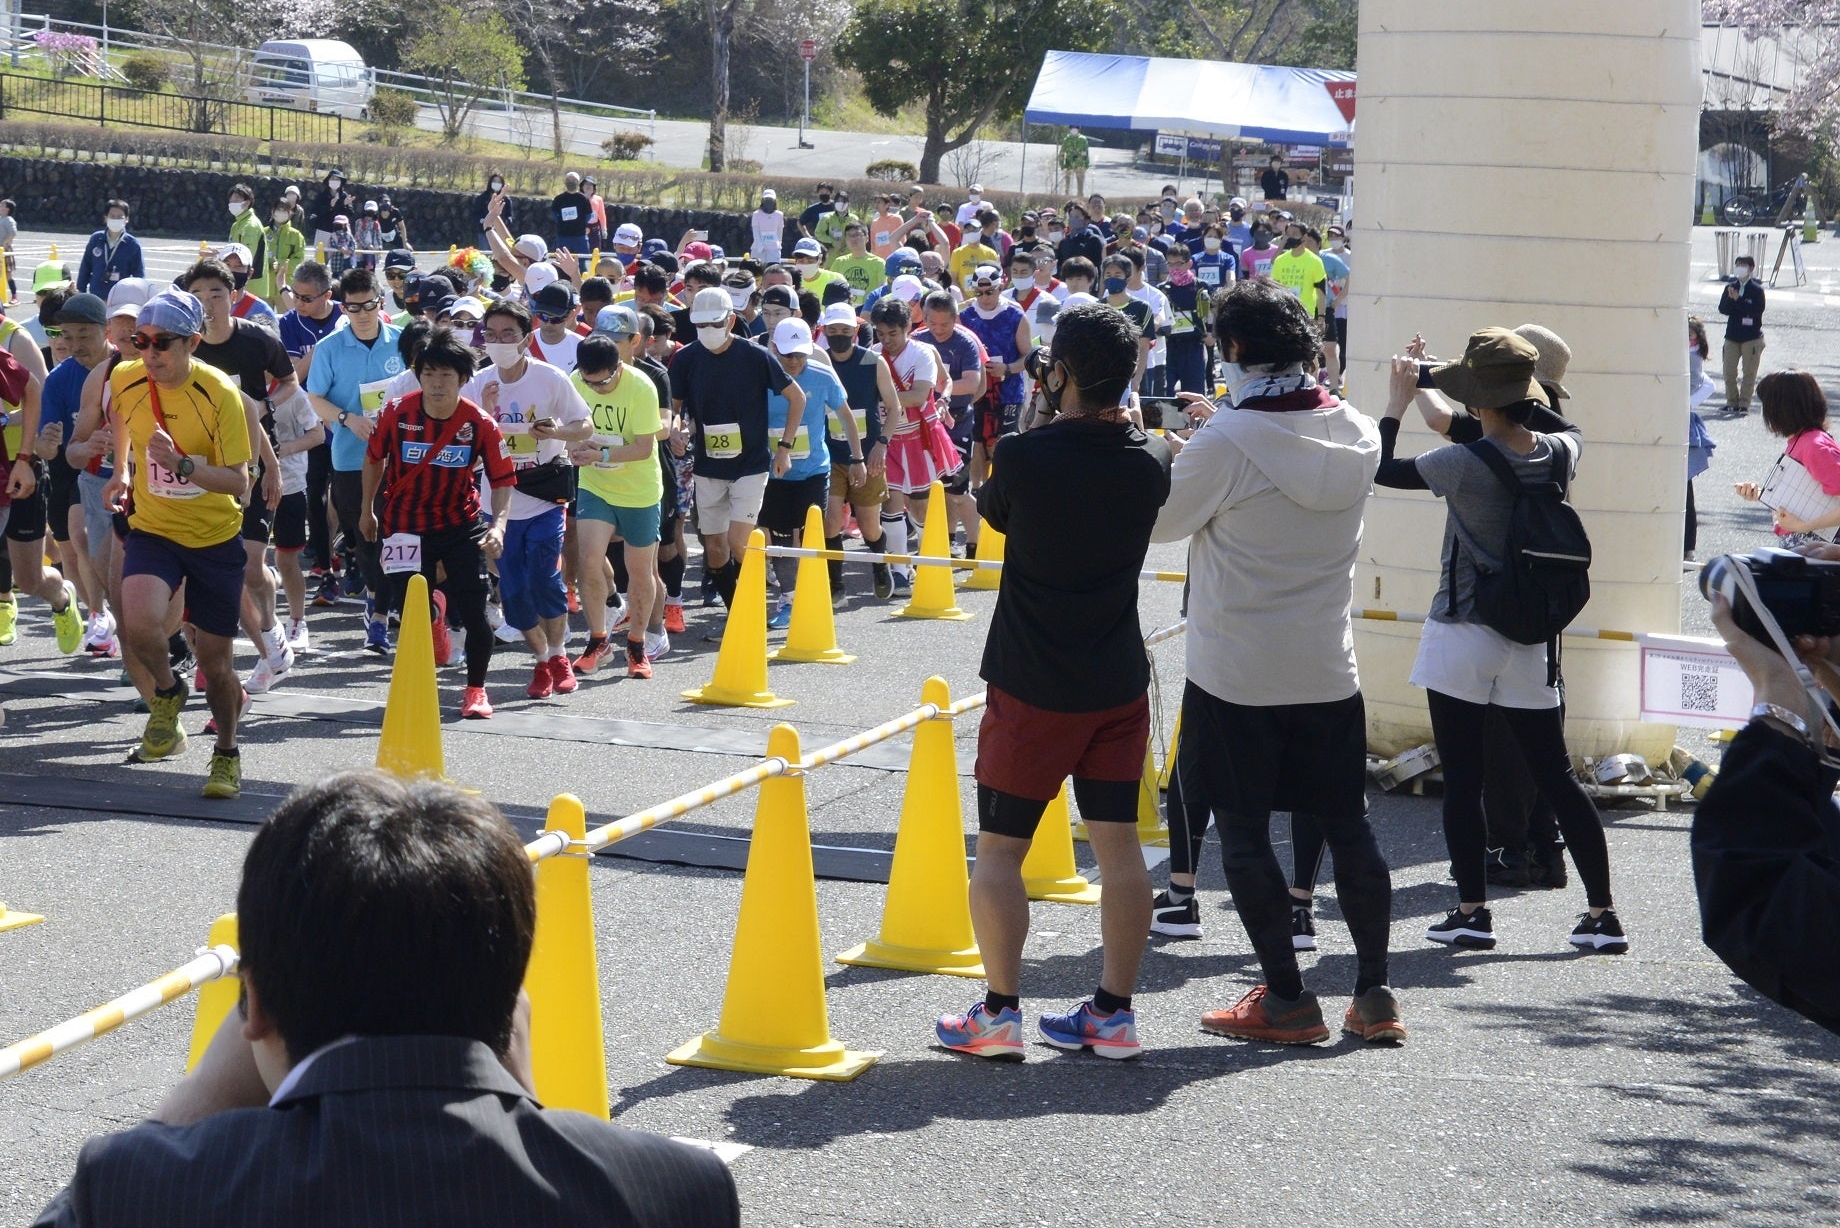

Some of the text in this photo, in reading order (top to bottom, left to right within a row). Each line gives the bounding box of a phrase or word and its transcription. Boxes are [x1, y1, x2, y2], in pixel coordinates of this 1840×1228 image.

[1334, 88, 1357, 99] 止ま
[710, 434, 730, 449] 28
[383, 545, 419, 562] 217
